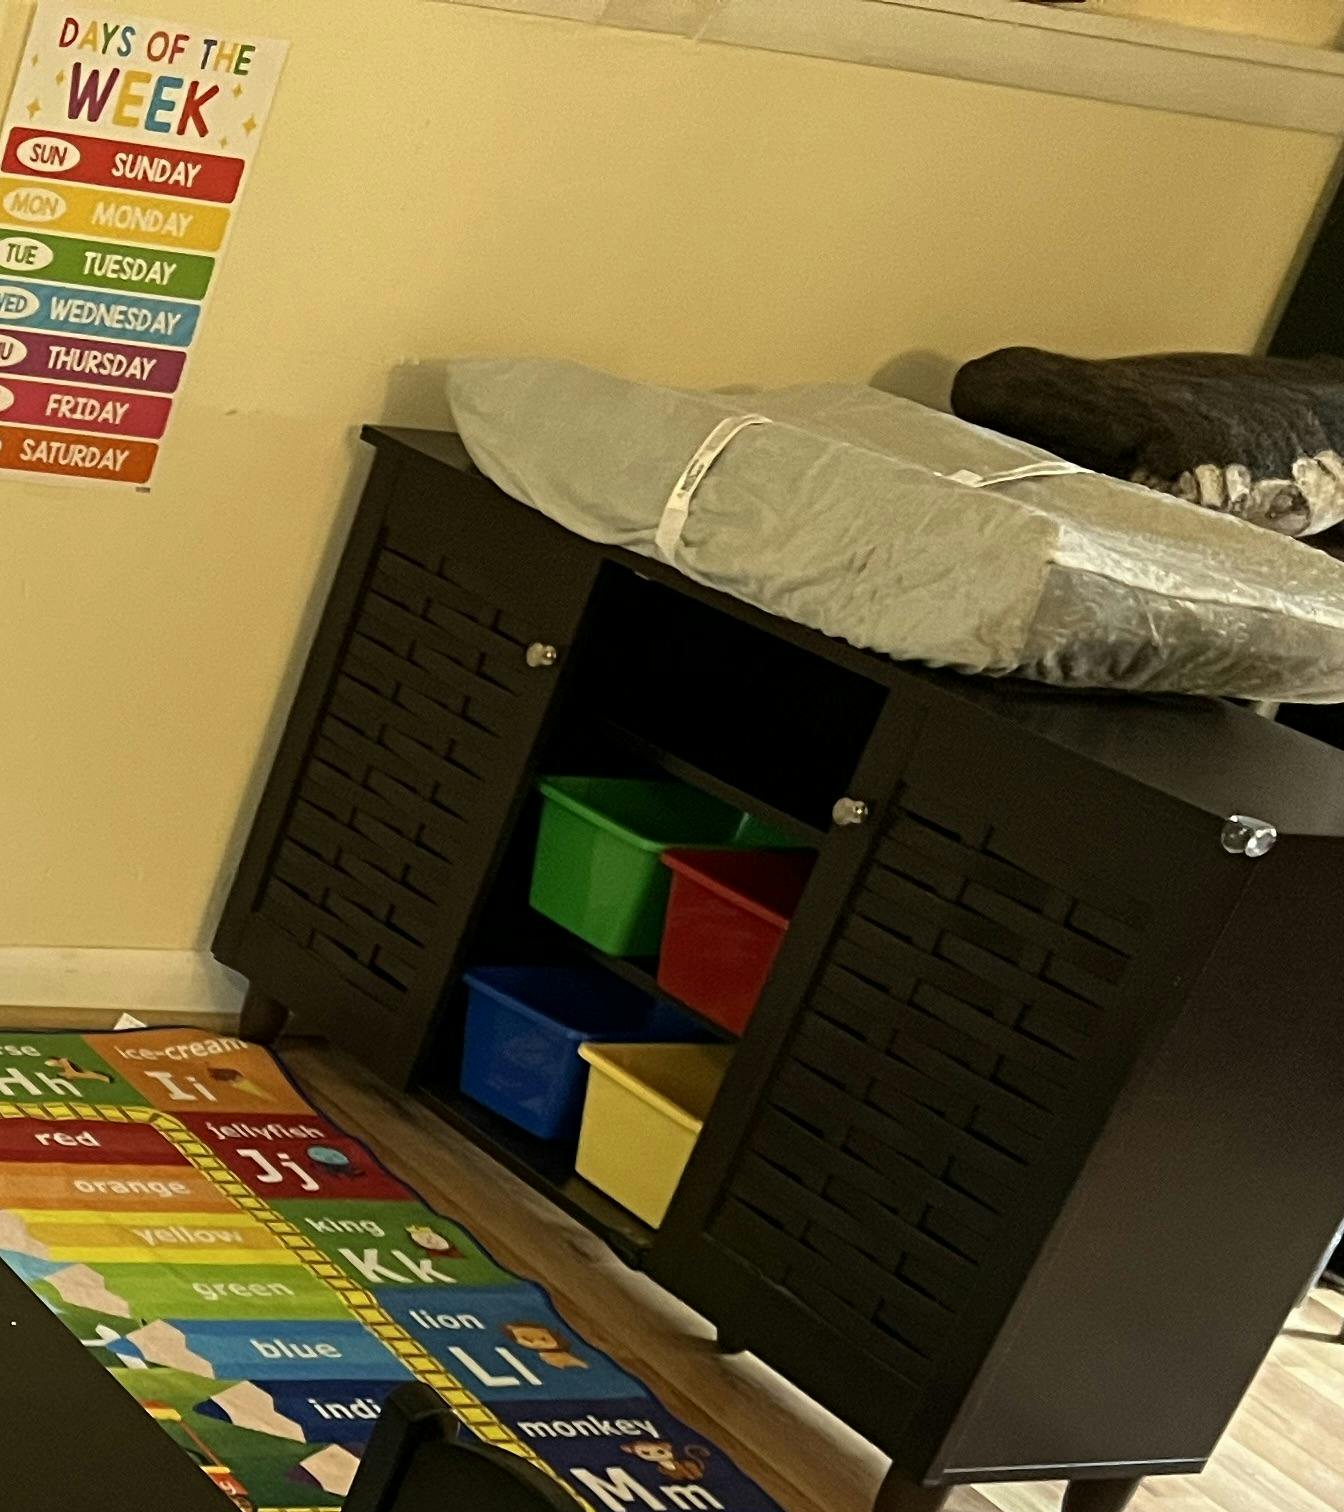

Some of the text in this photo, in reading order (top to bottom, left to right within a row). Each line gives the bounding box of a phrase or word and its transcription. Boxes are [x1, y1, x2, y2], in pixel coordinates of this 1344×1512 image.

[59, 17, 256, 76] DAYS OF THE
[67, 61, 220, 139] WEEK
[29, 143, 201, 188] SUN SUNDAY
[9, 192, 193, 238] MON MONDAY
[5, 243, 176, 286] TUE TUESDAY
[50, 297, 181, 336] WEDNESDAY
[48, 345, 157, 381] THURSDAY
[45, 394, 129, 425] FRIDAY
[20, 439, 130, 471] SATURDAY
[34, 1128, 101, 1149] red
[207, 1121, 325, 1143] jellyfish
[74, 1178, 191, 1197] orange
[133, 1225, 243, 1247] yellow
[305, 1217, 386, 1237] king
[193, 1278, 295, 1300] green
[409, 1308, 486, 1331] lion
[249, 1338, 342, 1361] blue
[517, 1415, 660, 1440] monkey
